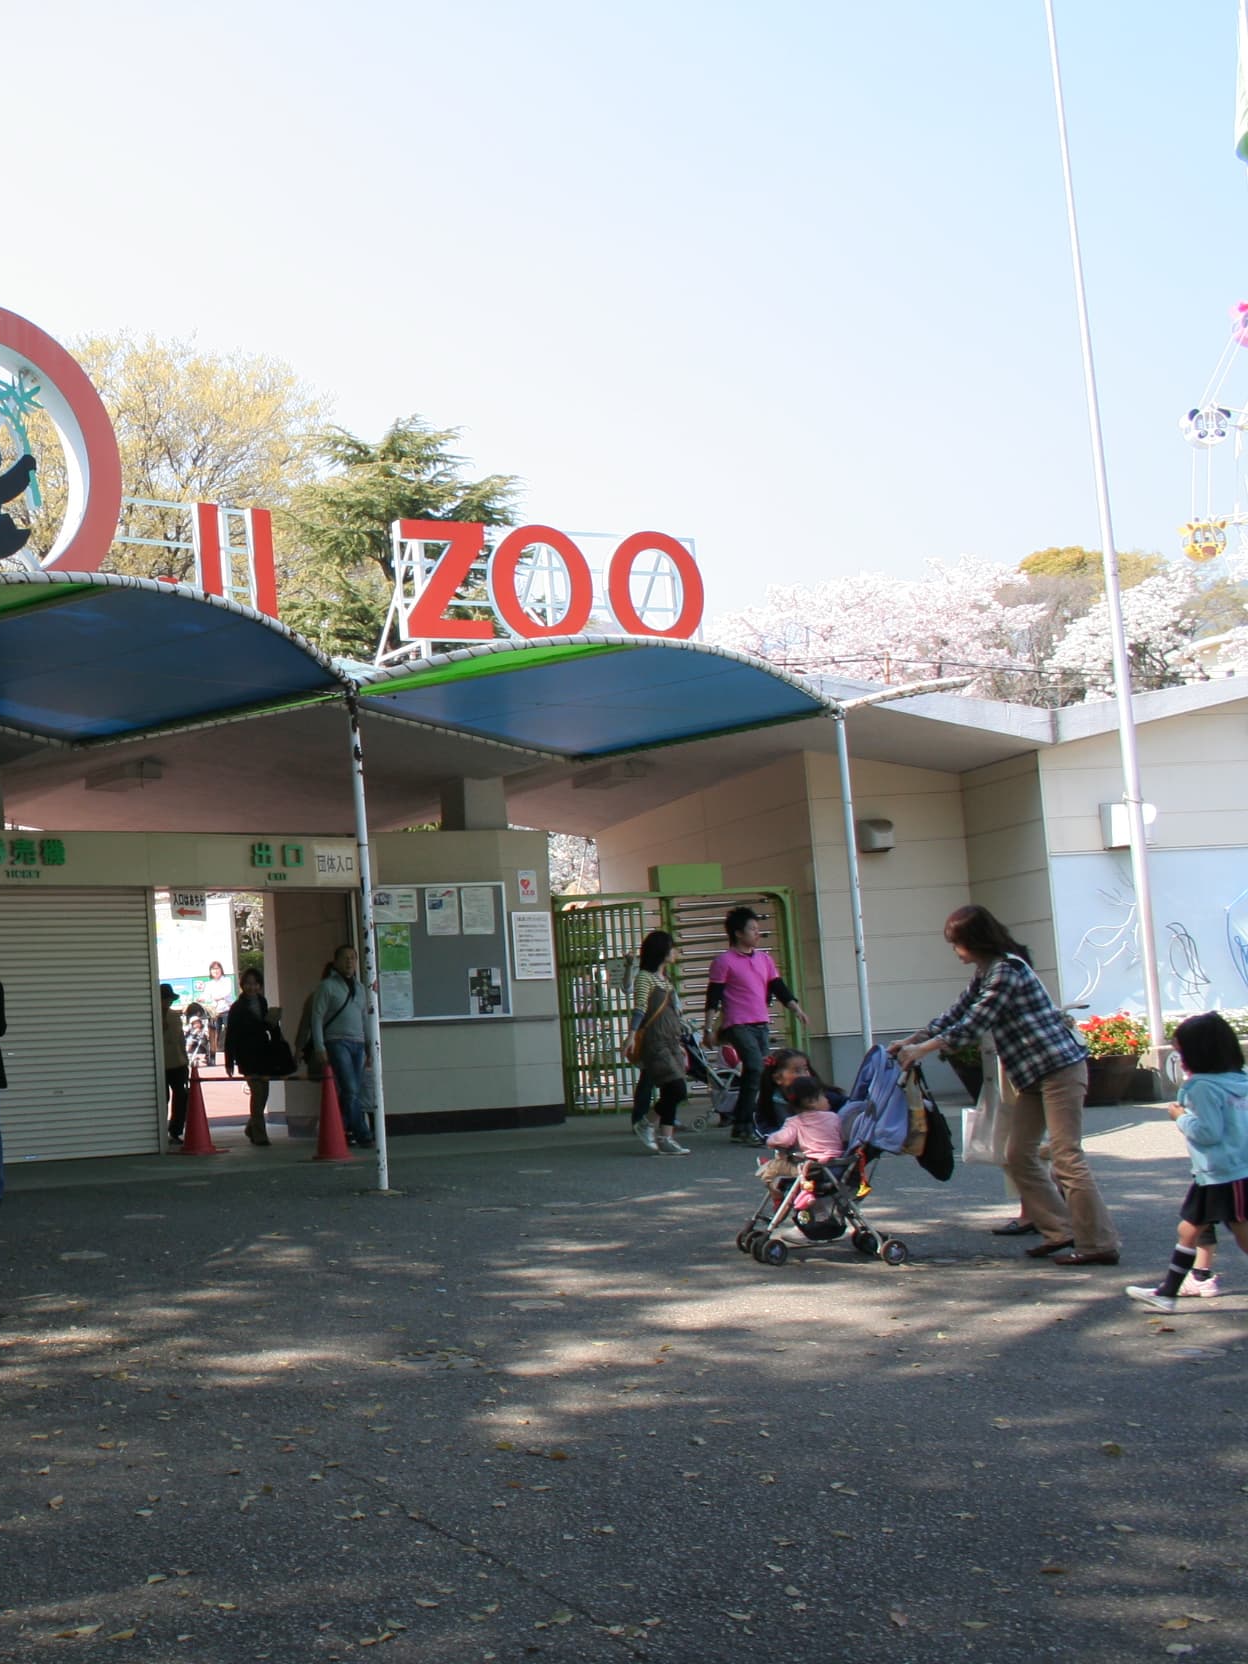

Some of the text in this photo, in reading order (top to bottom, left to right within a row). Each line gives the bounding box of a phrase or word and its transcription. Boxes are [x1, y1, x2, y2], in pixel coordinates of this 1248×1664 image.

[397, 519, 705, 640] ZOO
[251, 842, 304, 868] 出口
[316, 854, 353, 873] 団体入口
[5, 870, 41, 879] TICKET
[268, 872, 287, 881] EXIT
